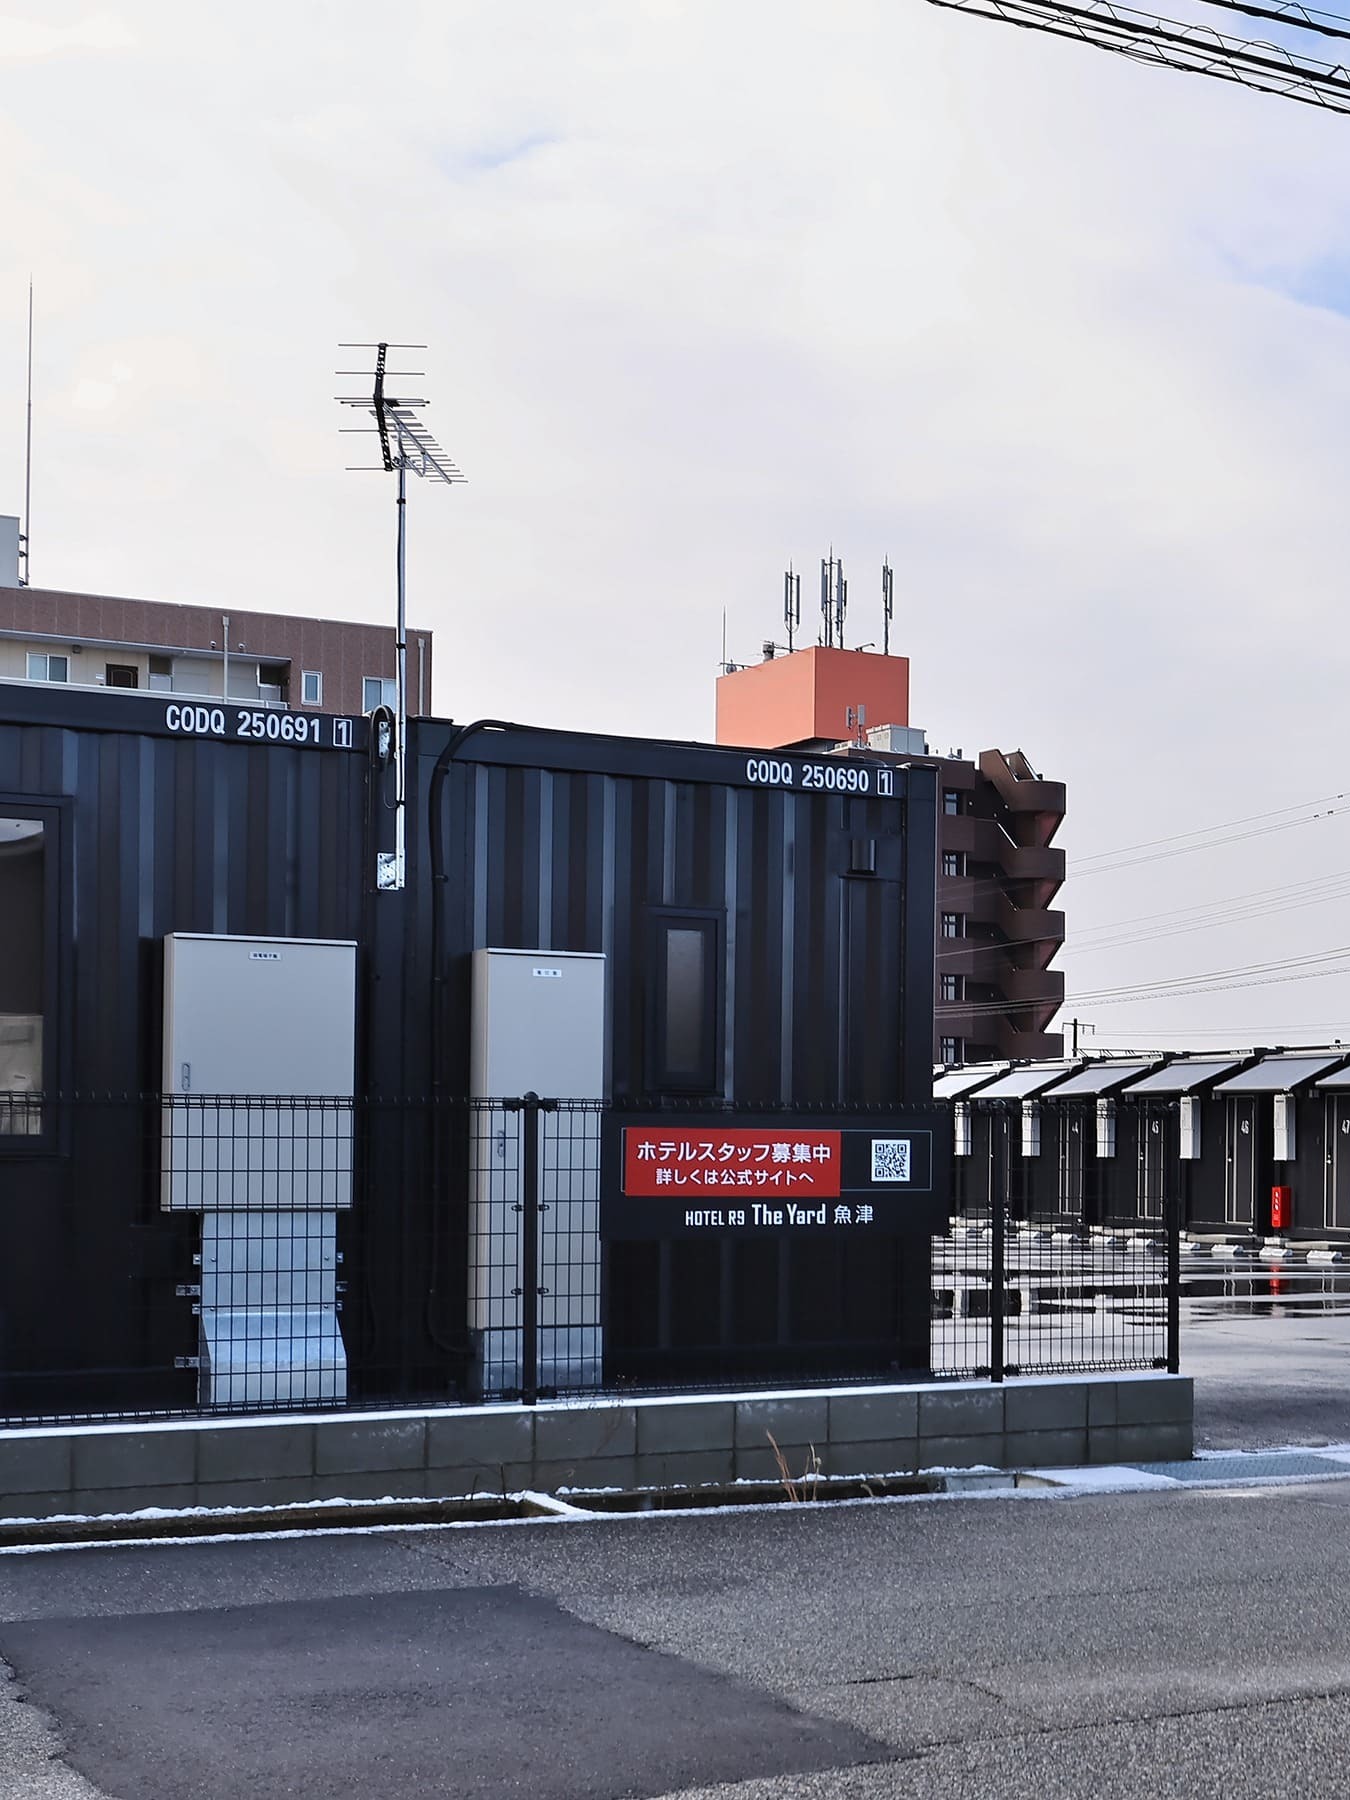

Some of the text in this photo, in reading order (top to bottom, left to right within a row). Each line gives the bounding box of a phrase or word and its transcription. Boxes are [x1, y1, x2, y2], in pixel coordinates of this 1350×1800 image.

[166, 704, 225, 735] CODQ
[237, 710, 320, 743] 250691
[746, 759, 793, 785] CODQ
[801, 764, 869, 792] 250690
[1341, 1119, 1350, 1135] 47
[636, 1141, 831, 1165] ホテルスタッフ募集中
[656, 1167, 814, 1187] 詳しくは公式サイトへ
[685, 1203, 874, 1227] HOTEL R9 The Yard 魚津
